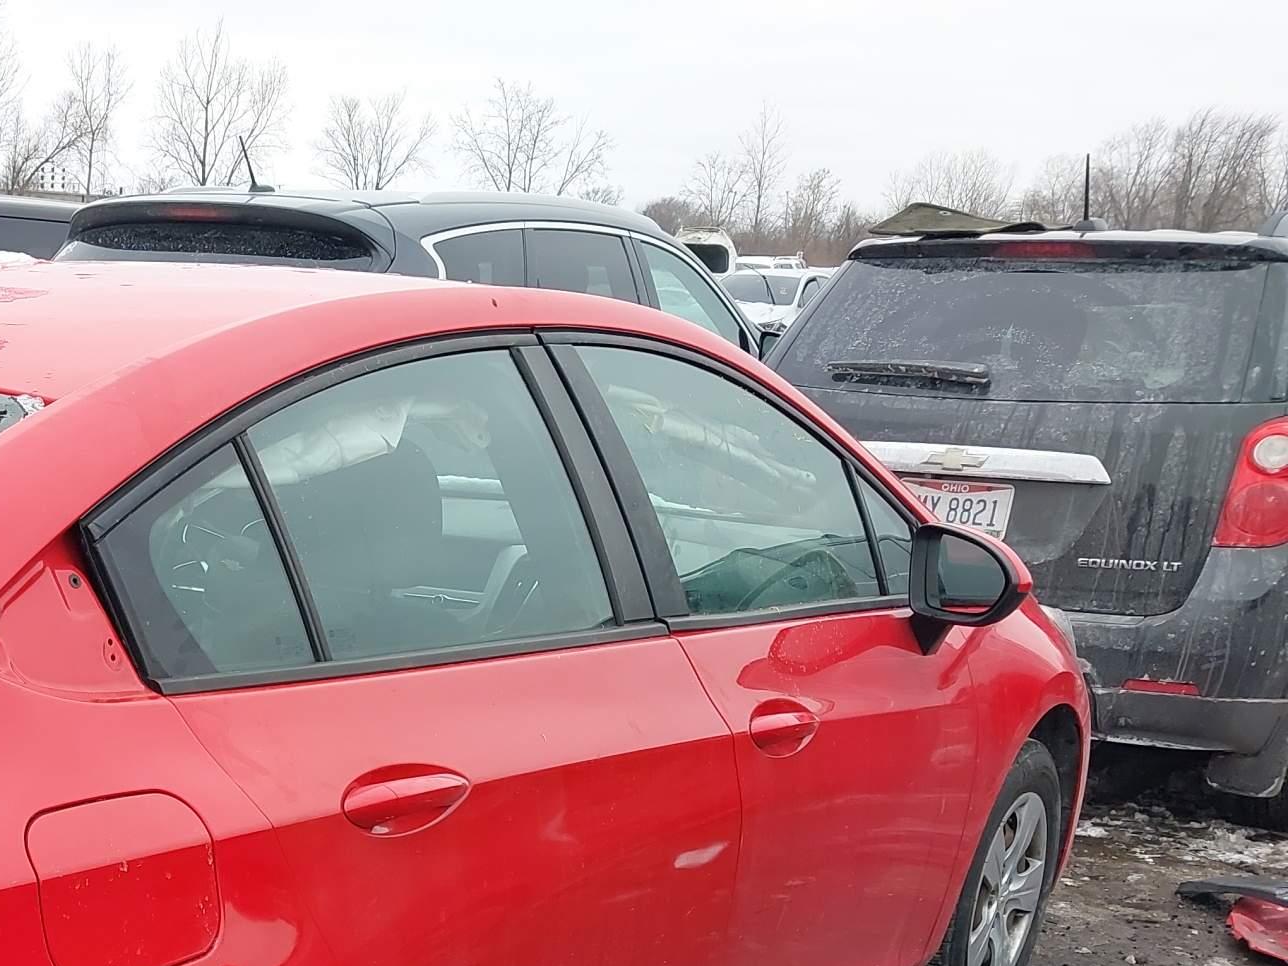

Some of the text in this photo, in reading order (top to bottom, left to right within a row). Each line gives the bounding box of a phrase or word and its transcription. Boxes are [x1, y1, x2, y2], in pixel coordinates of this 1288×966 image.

[941, 483, 970, 493] OHIO
[946, 497, 998, 527] 8821
[1077, 557, 1184, 572] EQUINOX LT
